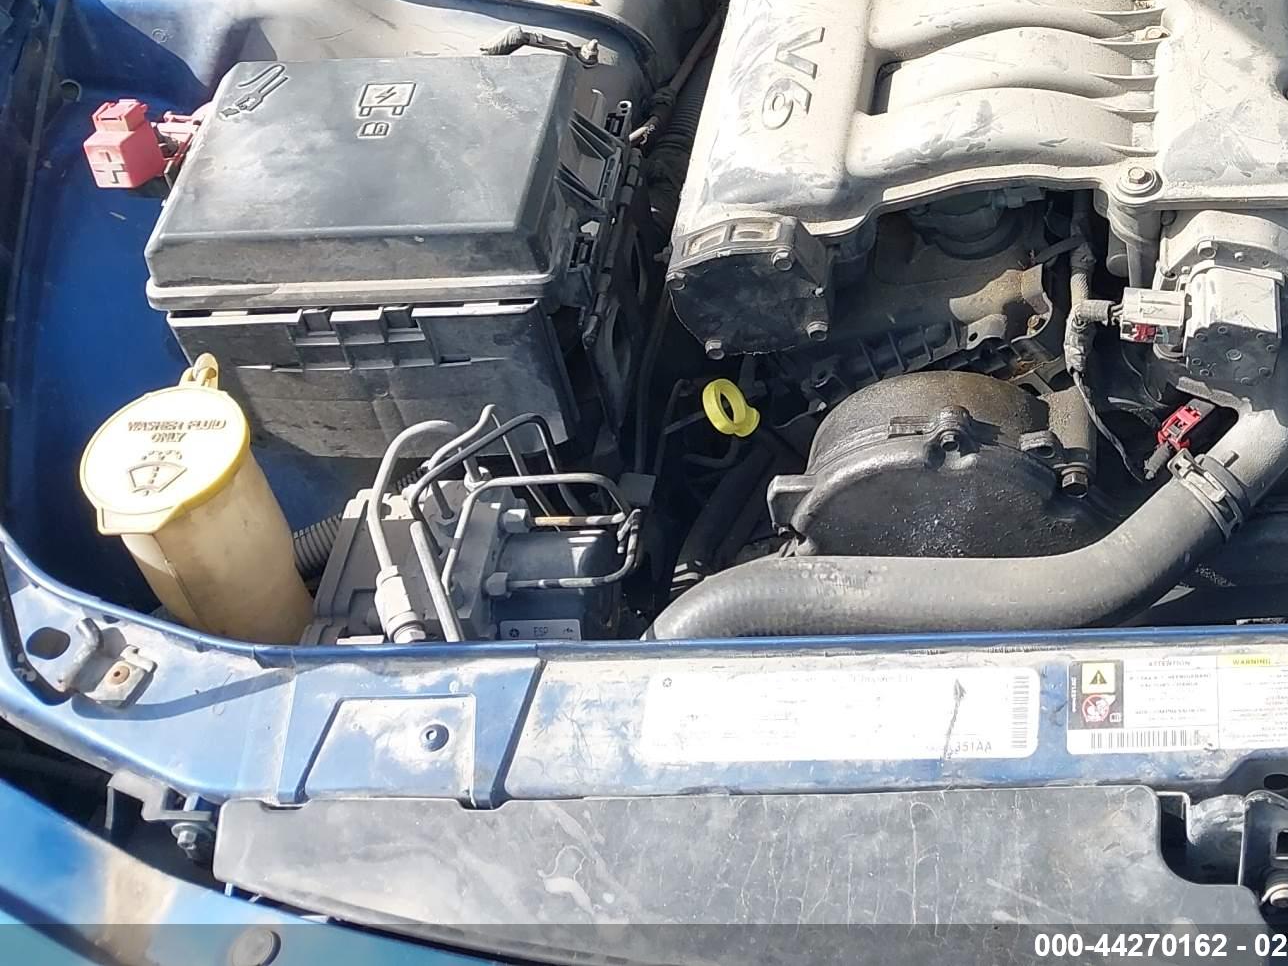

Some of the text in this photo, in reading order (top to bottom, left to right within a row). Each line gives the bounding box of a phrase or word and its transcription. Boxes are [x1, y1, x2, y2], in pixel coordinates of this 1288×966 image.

[761, 26, 827, 131] V6
[187, 419, 227, 431] FLUID
[151, 432, 187, 443] ONLY
